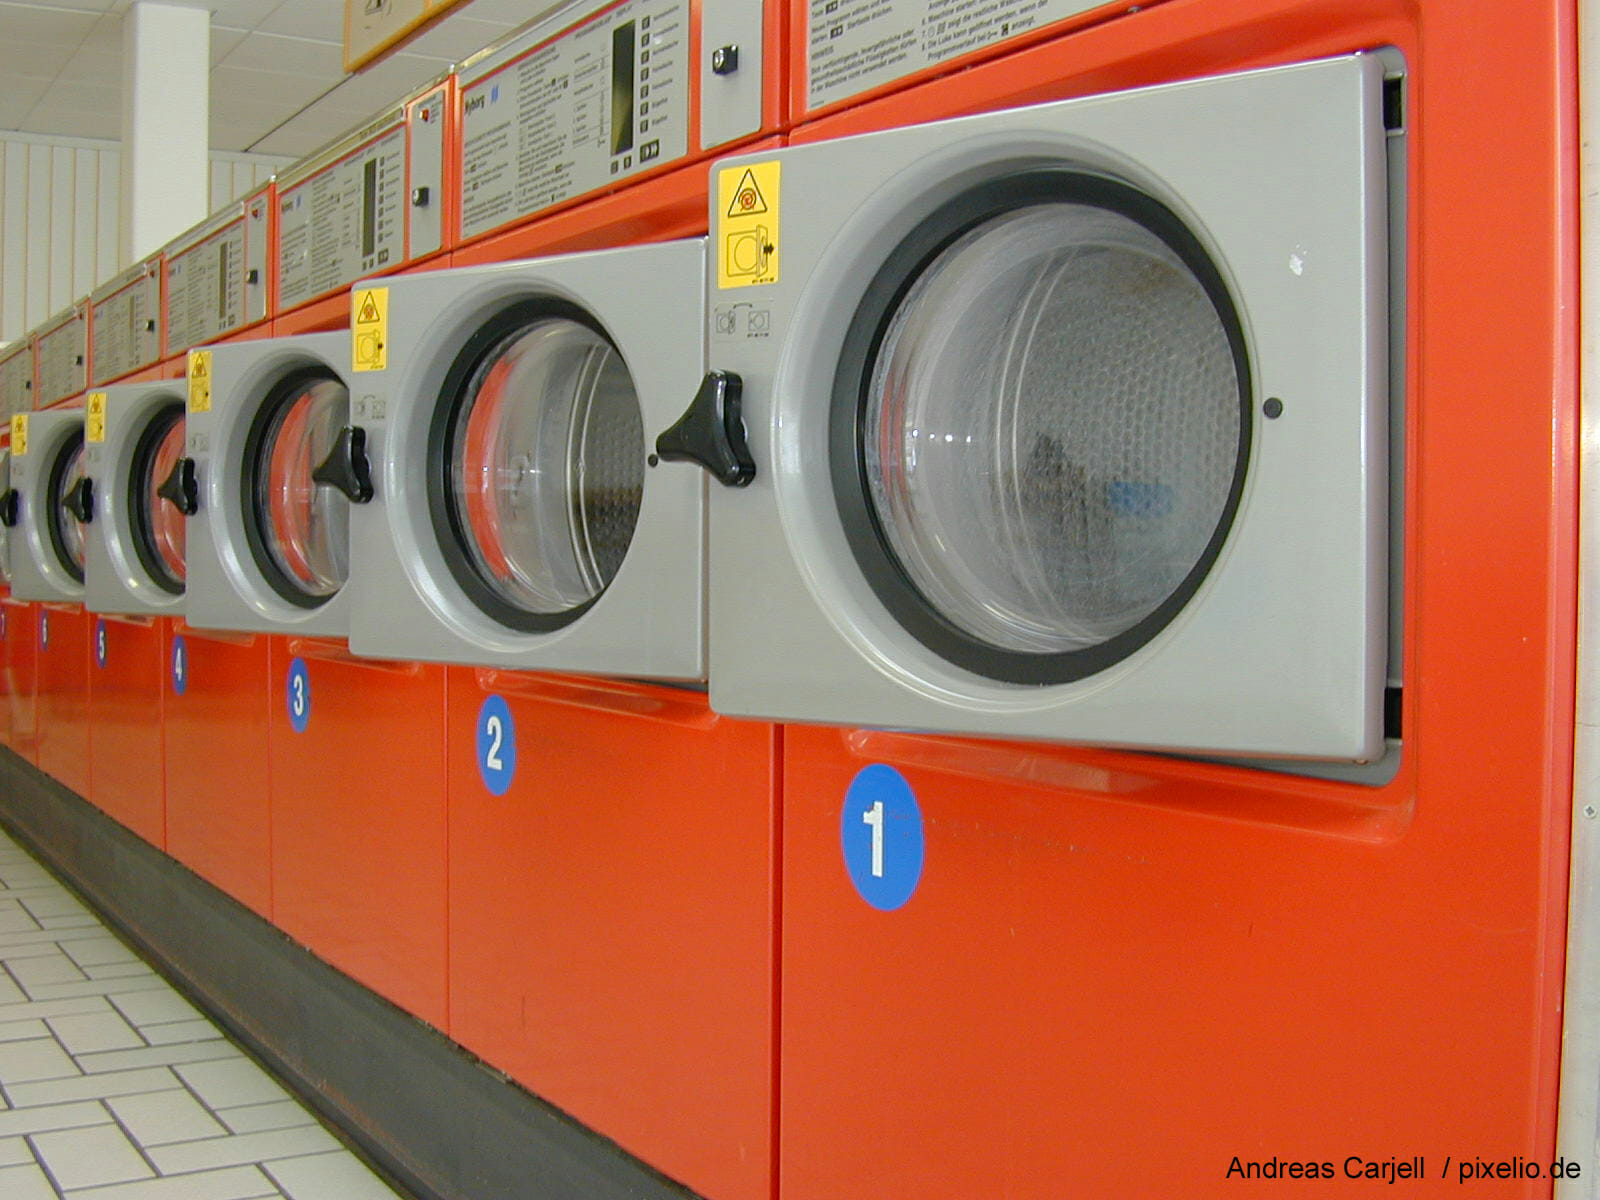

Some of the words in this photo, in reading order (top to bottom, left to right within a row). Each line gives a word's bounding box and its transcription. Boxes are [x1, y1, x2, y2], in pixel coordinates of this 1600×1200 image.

[98, 632, 105, 659] 5
[175, 648, 183, 681] 4
[294, 675, 304, 716] 3
[486, 716, 503, 771] 2
[862, 801, 883, 878] 1
